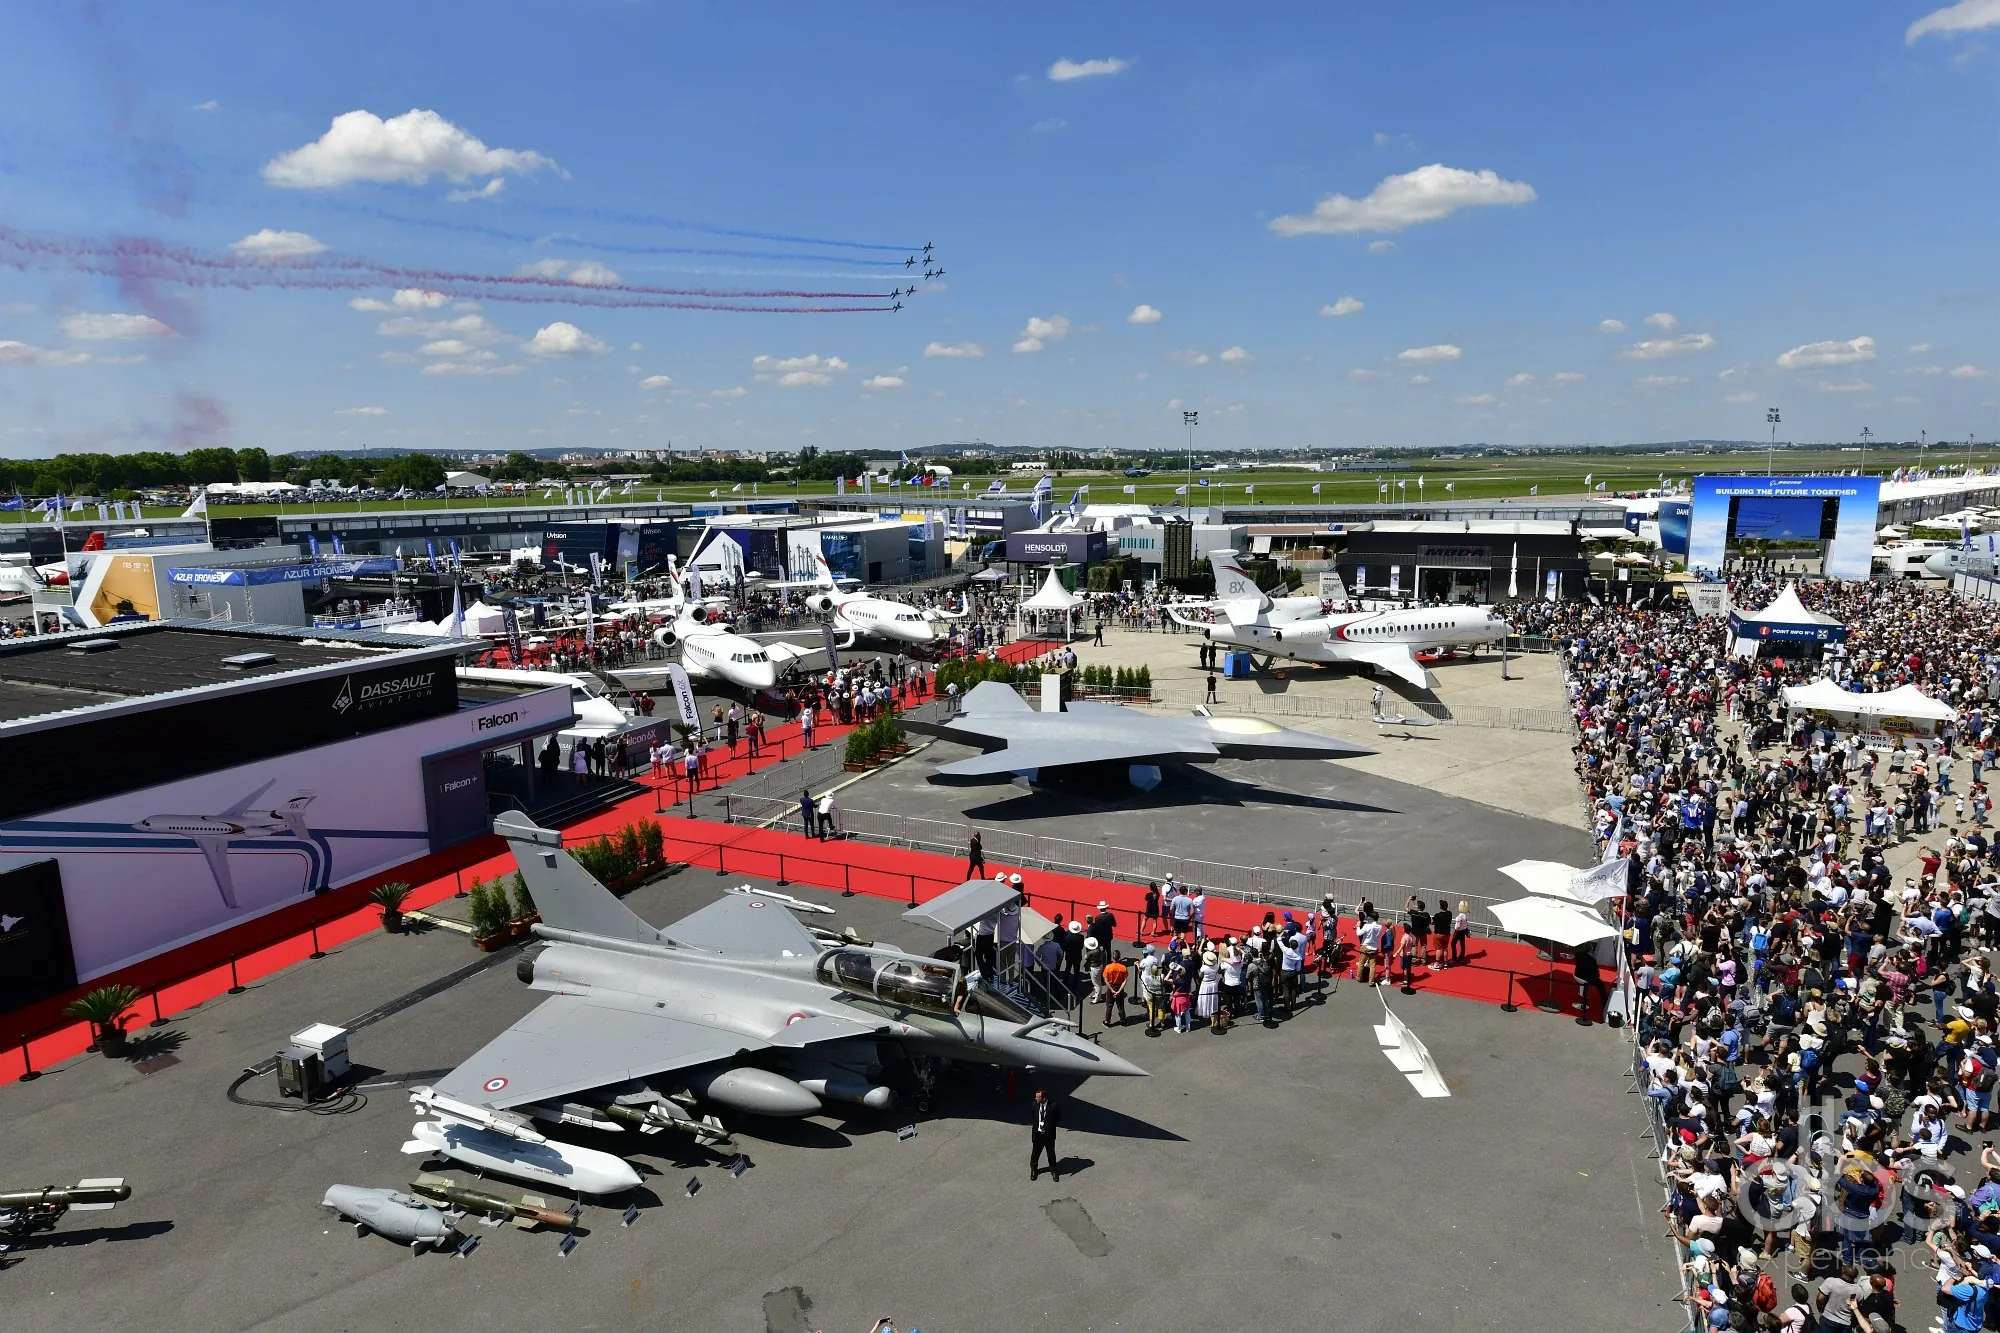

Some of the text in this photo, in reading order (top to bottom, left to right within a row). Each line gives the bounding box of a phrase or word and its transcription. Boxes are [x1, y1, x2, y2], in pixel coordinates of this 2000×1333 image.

[1024, 544, 1065, 552] HENSOLDT
[173, 573, 221, 583] AZUR DRONES
[283, 565, 351, 580] AZUR DRONES
[1228, 581, 1246, 594] 8X
[360, 672, 435, 699] DASSAULT
[358, 689, 432, 711] AVIATION
[677, 679, 694, 719] Falcon 6X
[477, 709, 519, 731] Falcon
[647, 729, 657, 740] 6X
[444, 777, 471, 793] Falcon
